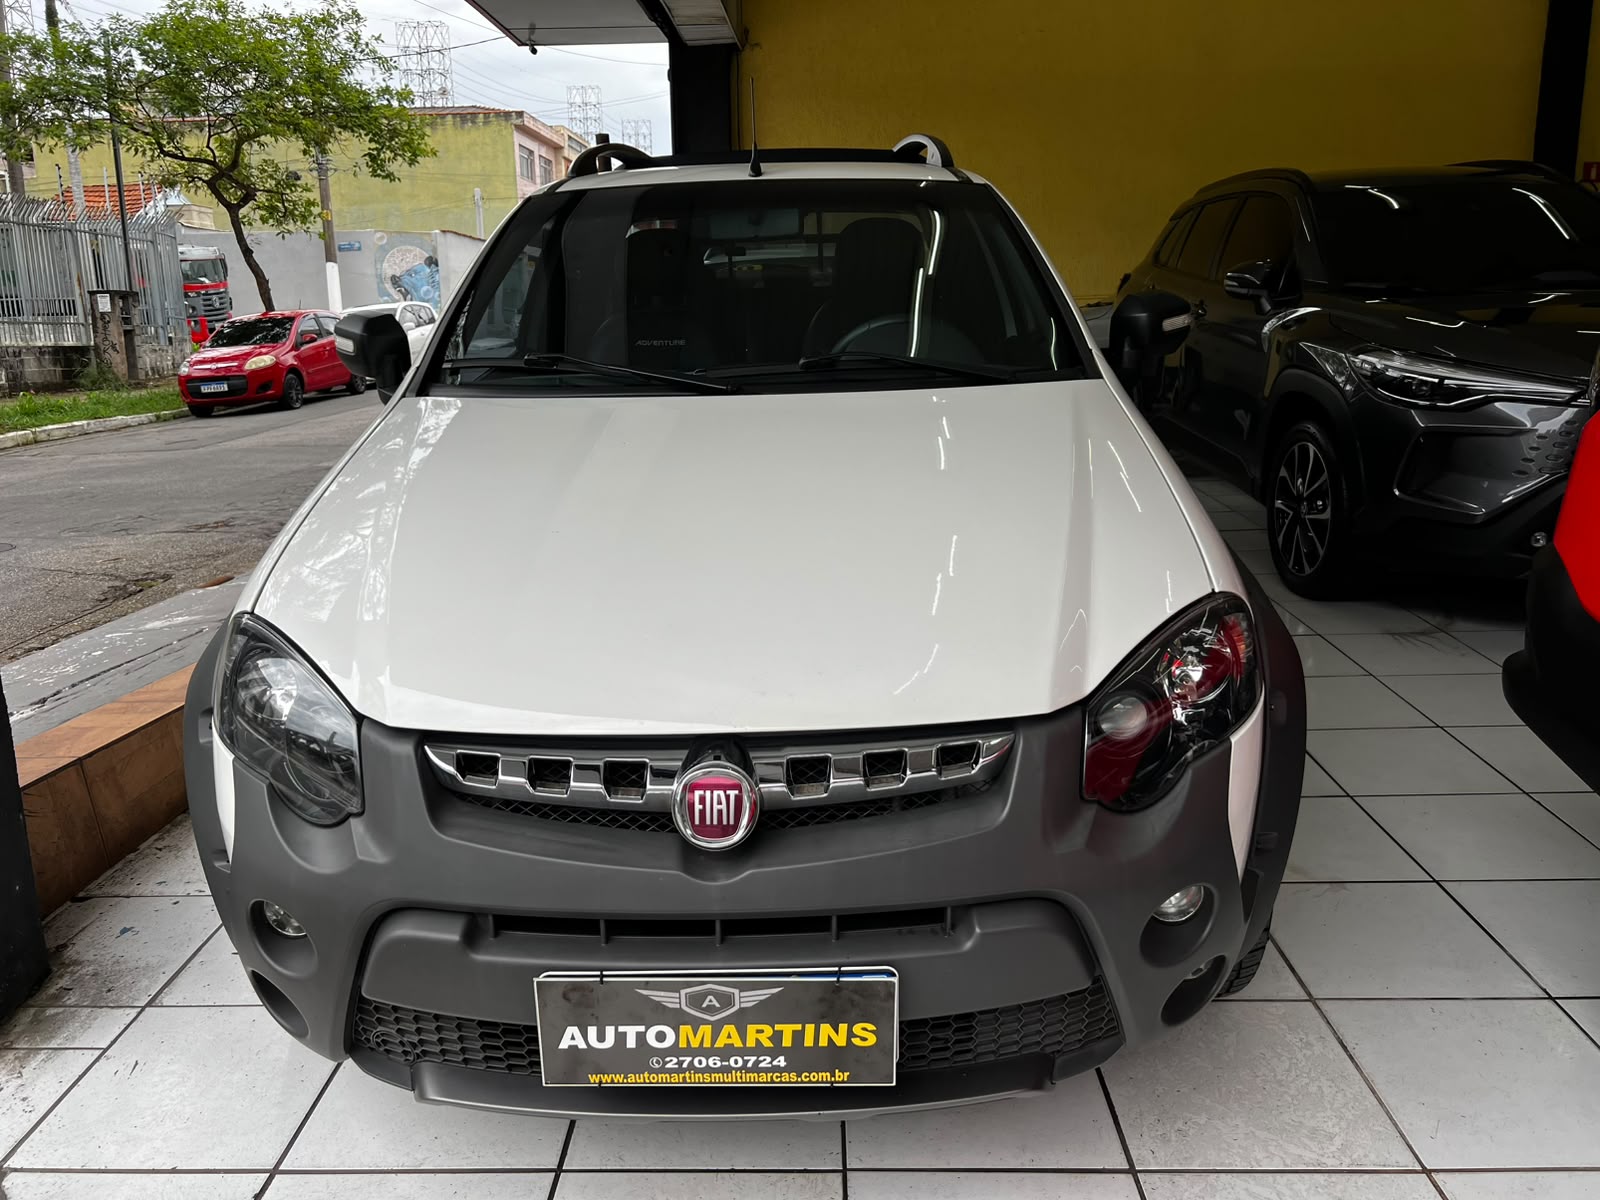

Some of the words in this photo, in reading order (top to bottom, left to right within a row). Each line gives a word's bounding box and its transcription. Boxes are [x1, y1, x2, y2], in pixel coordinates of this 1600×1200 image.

[694, 790, 739, 825] FIAT
[701, 995, 721, 1008] A
[558, 1022, 877, 1049] AUTOMARTINS
[664, 1055, 787, 1069] 2706-0724
[588, 1068, 850, 1084] www.automartinsmultimarcas.com.br
